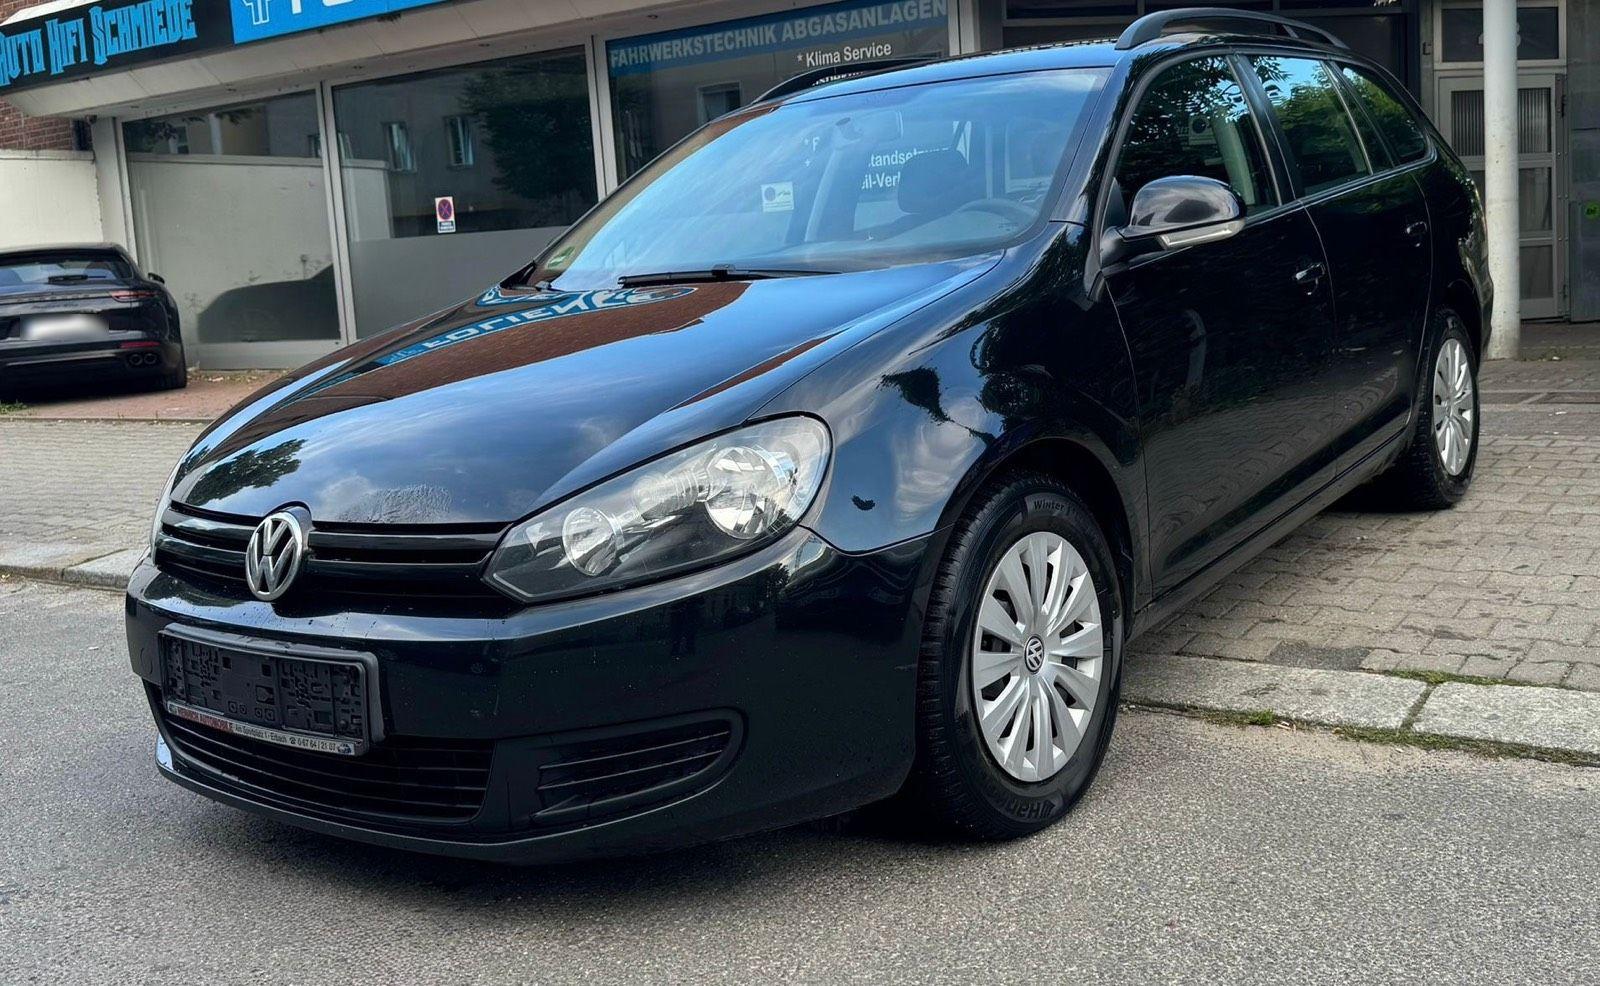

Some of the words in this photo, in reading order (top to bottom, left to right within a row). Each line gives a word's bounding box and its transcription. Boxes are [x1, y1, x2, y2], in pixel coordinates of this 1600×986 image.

[45, 18, 88, 75] HIFI
[89, 0, 197, 65] SCHMIEDE
[610, 23, 777, 69] FAHRWERKSTECHNIK
[781, 0, 948, 43] ABGASANLAGEN
[806, 51, 841, 67] Klima
[844, 42, 892, 61] Service
